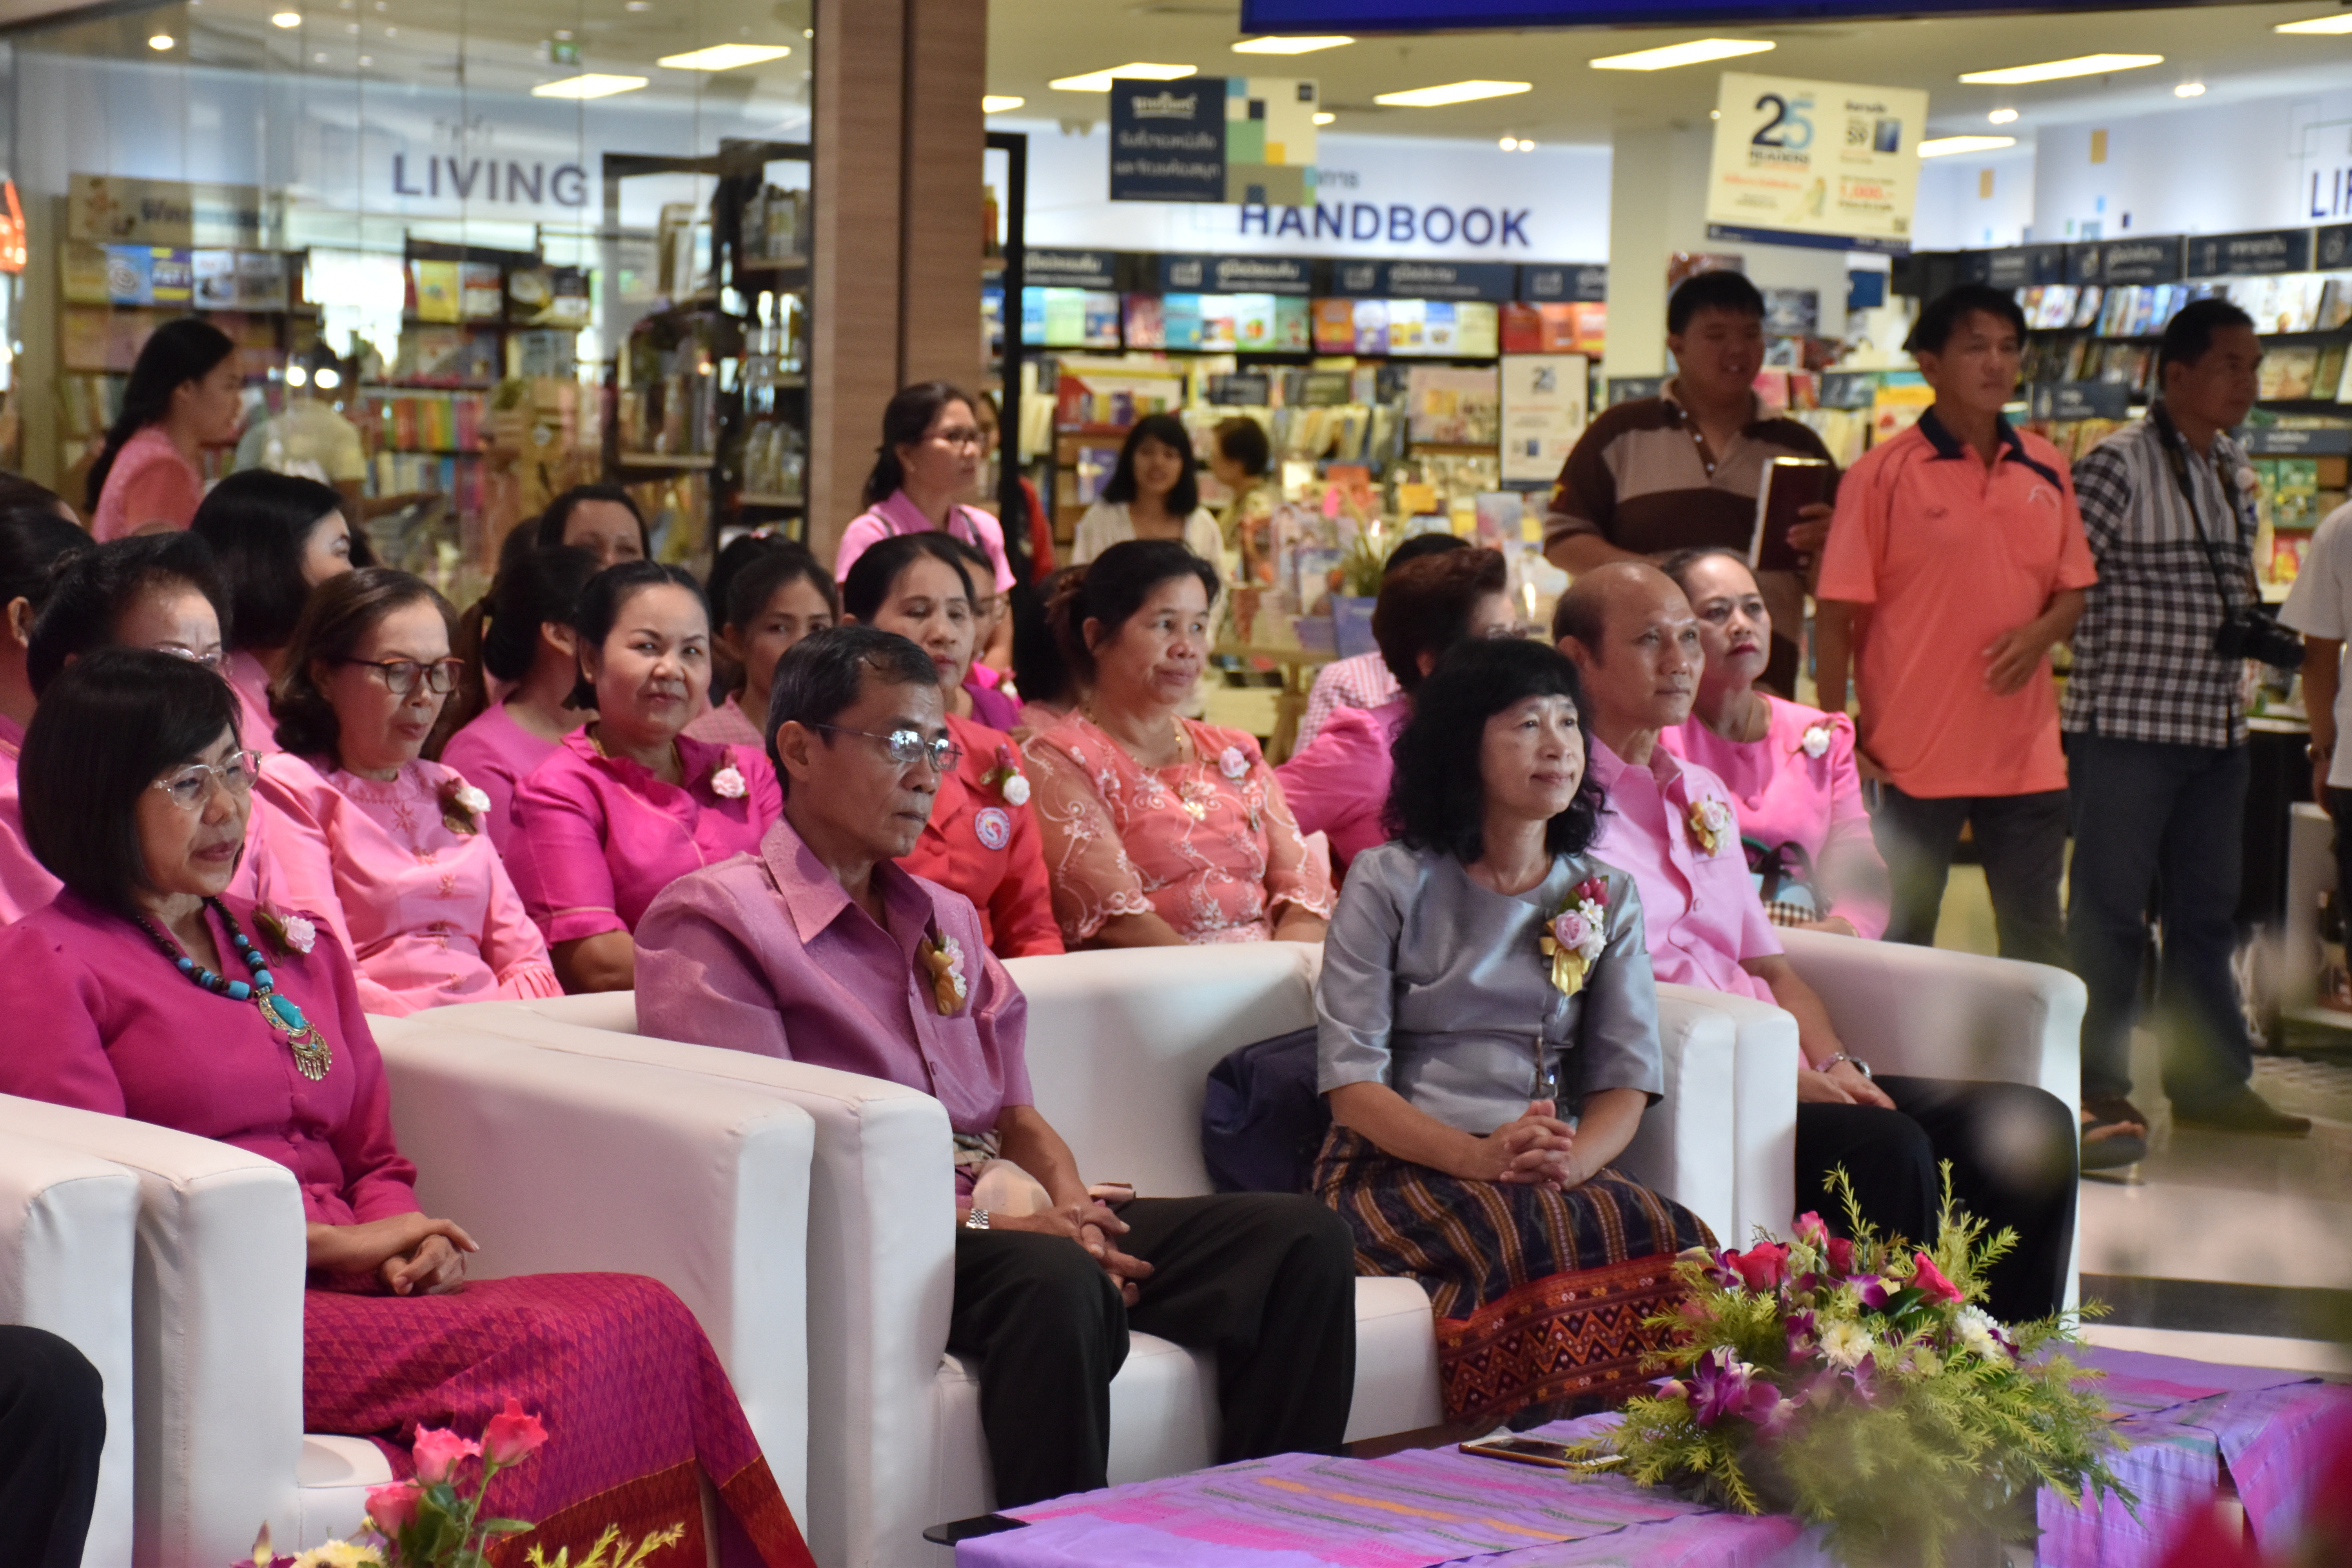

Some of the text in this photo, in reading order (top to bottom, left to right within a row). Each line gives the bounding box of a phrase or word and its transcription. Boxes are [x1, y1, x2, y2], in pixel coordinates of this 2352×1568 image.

[1751, 94, 1815, 150] 25
[393, 154, 588, 207] LIVING
[1240, 200, 1532, 247] HANDBOOK
